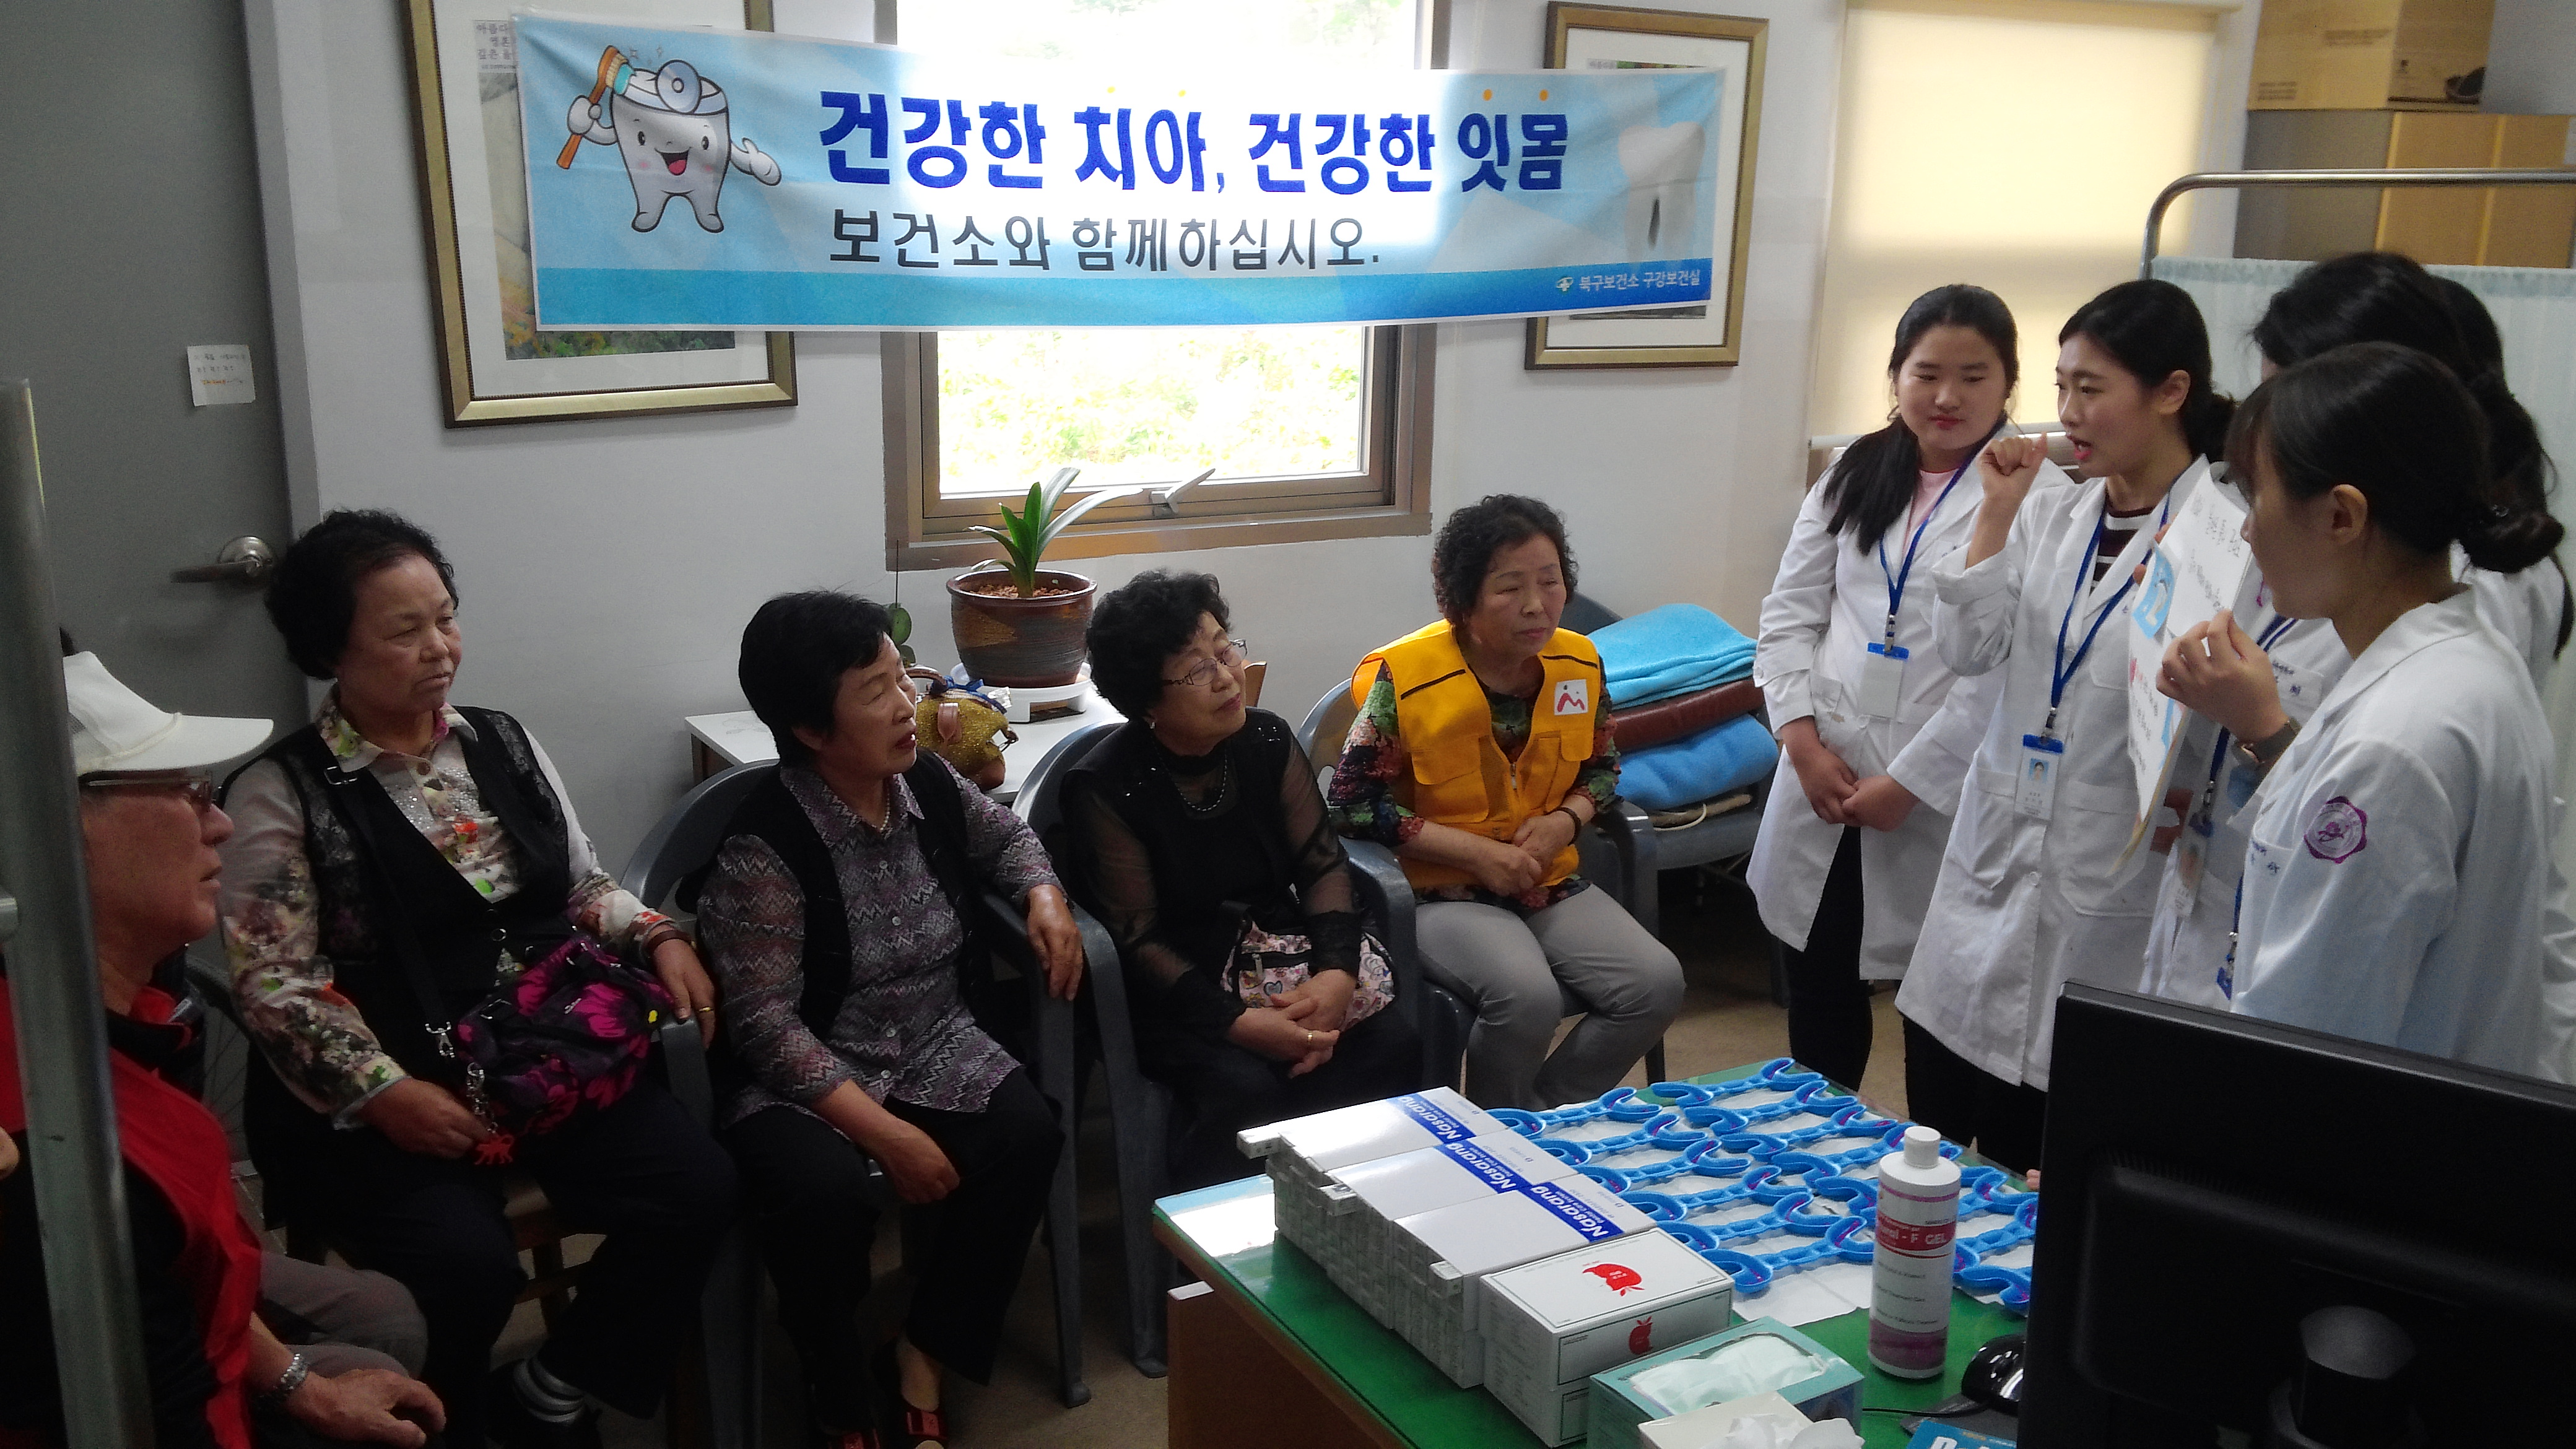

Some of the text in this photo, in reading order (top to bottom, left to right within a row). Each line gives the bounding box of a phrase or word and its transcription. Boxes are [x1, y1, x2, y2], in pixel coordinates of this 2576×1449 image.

[819, 90, 1569, 195] 건강한 치아, 건강한 잇몸
[830, 209, 1380, 271] 보건소와 함께하십시오.
[1579, 269, 1700, 292] 북구보건소 구강보건실
[1398, 1097, 1462, 1139] Nasarang
[1445, 1142, 1516, 1189] Nasarang
[1530, 1186, 1609, 1237] Nasarang
[1925, 1233, 1947, 1245] GEL
